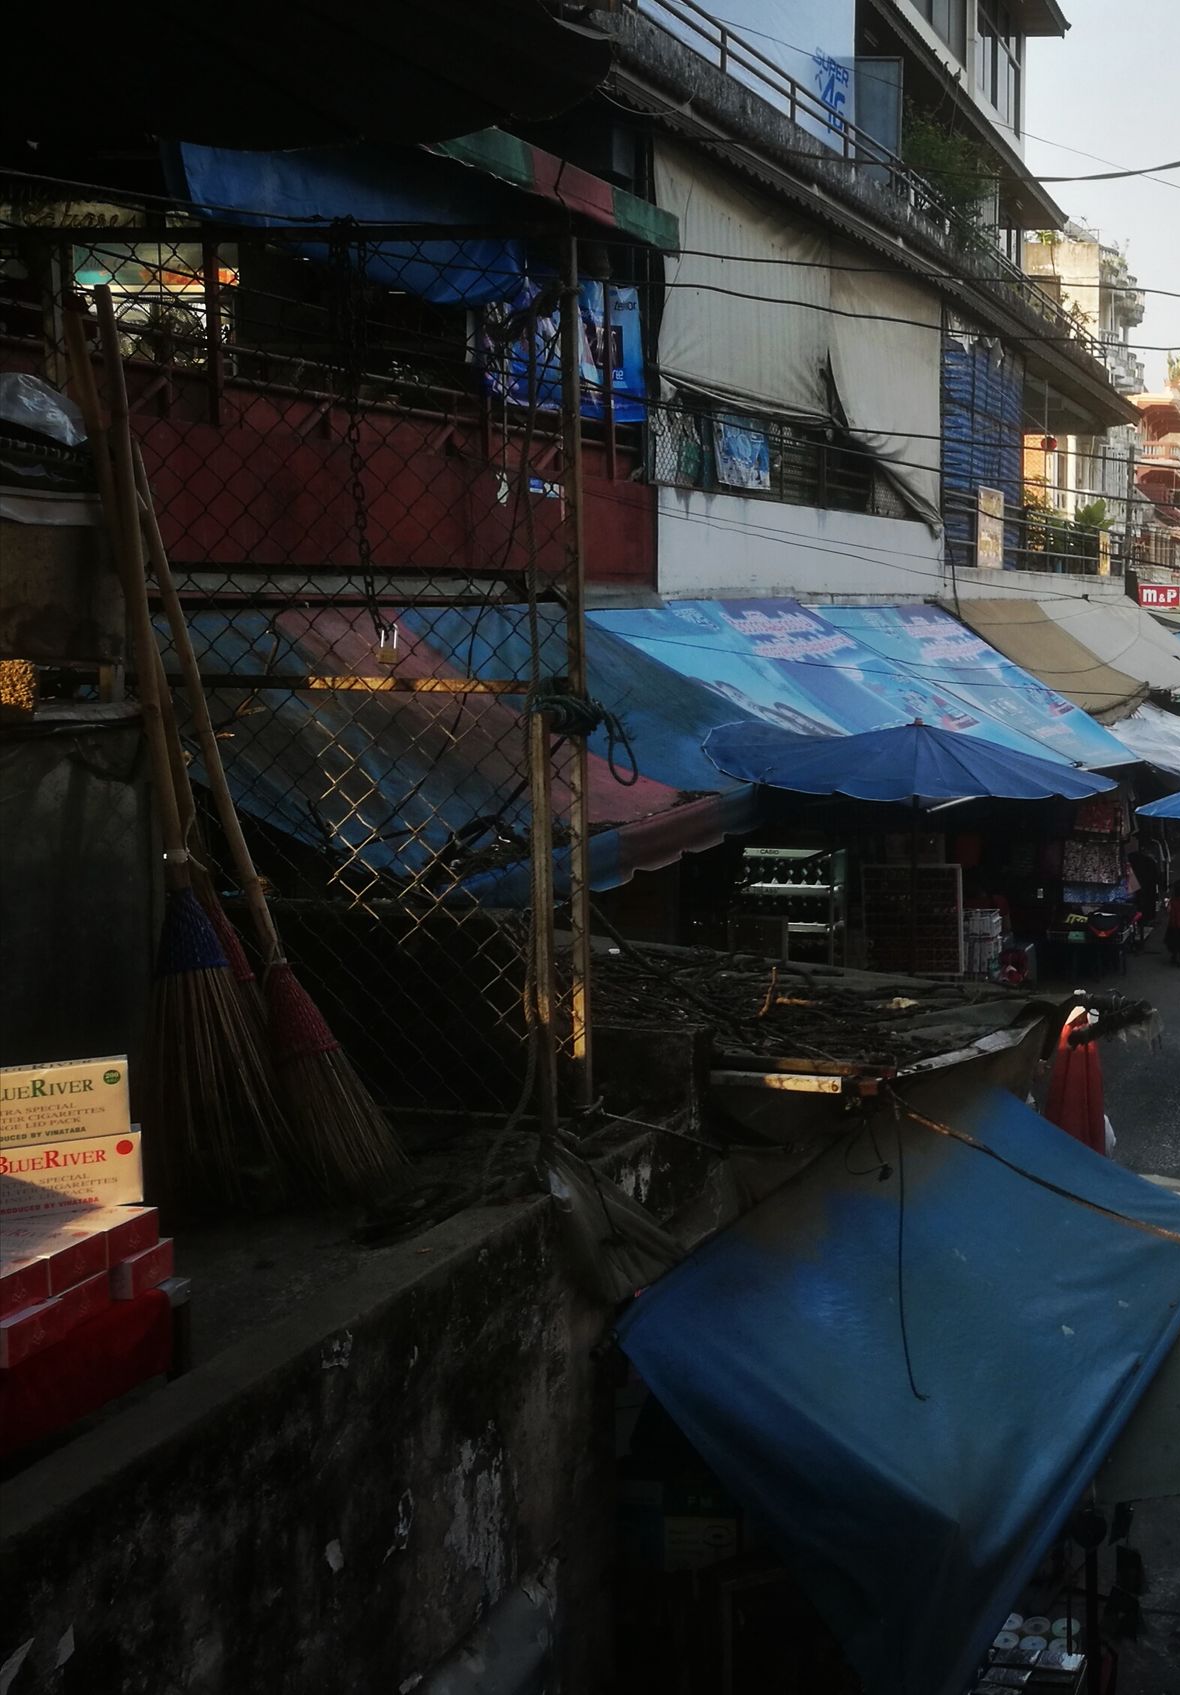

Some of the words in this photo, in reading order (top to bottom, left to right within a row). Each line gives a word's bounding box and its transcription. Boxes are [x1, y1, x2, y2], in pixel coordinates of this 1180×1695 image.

[26, 1103, 74, 1113] SPECIAL
[28, 1107, 105, 1121] CIGARETTES
[26, 1120, 47, 1129] LID
[50, 1117, 81, 1126] PACK
[40, 1173, 89, 1185] SPECIAL
